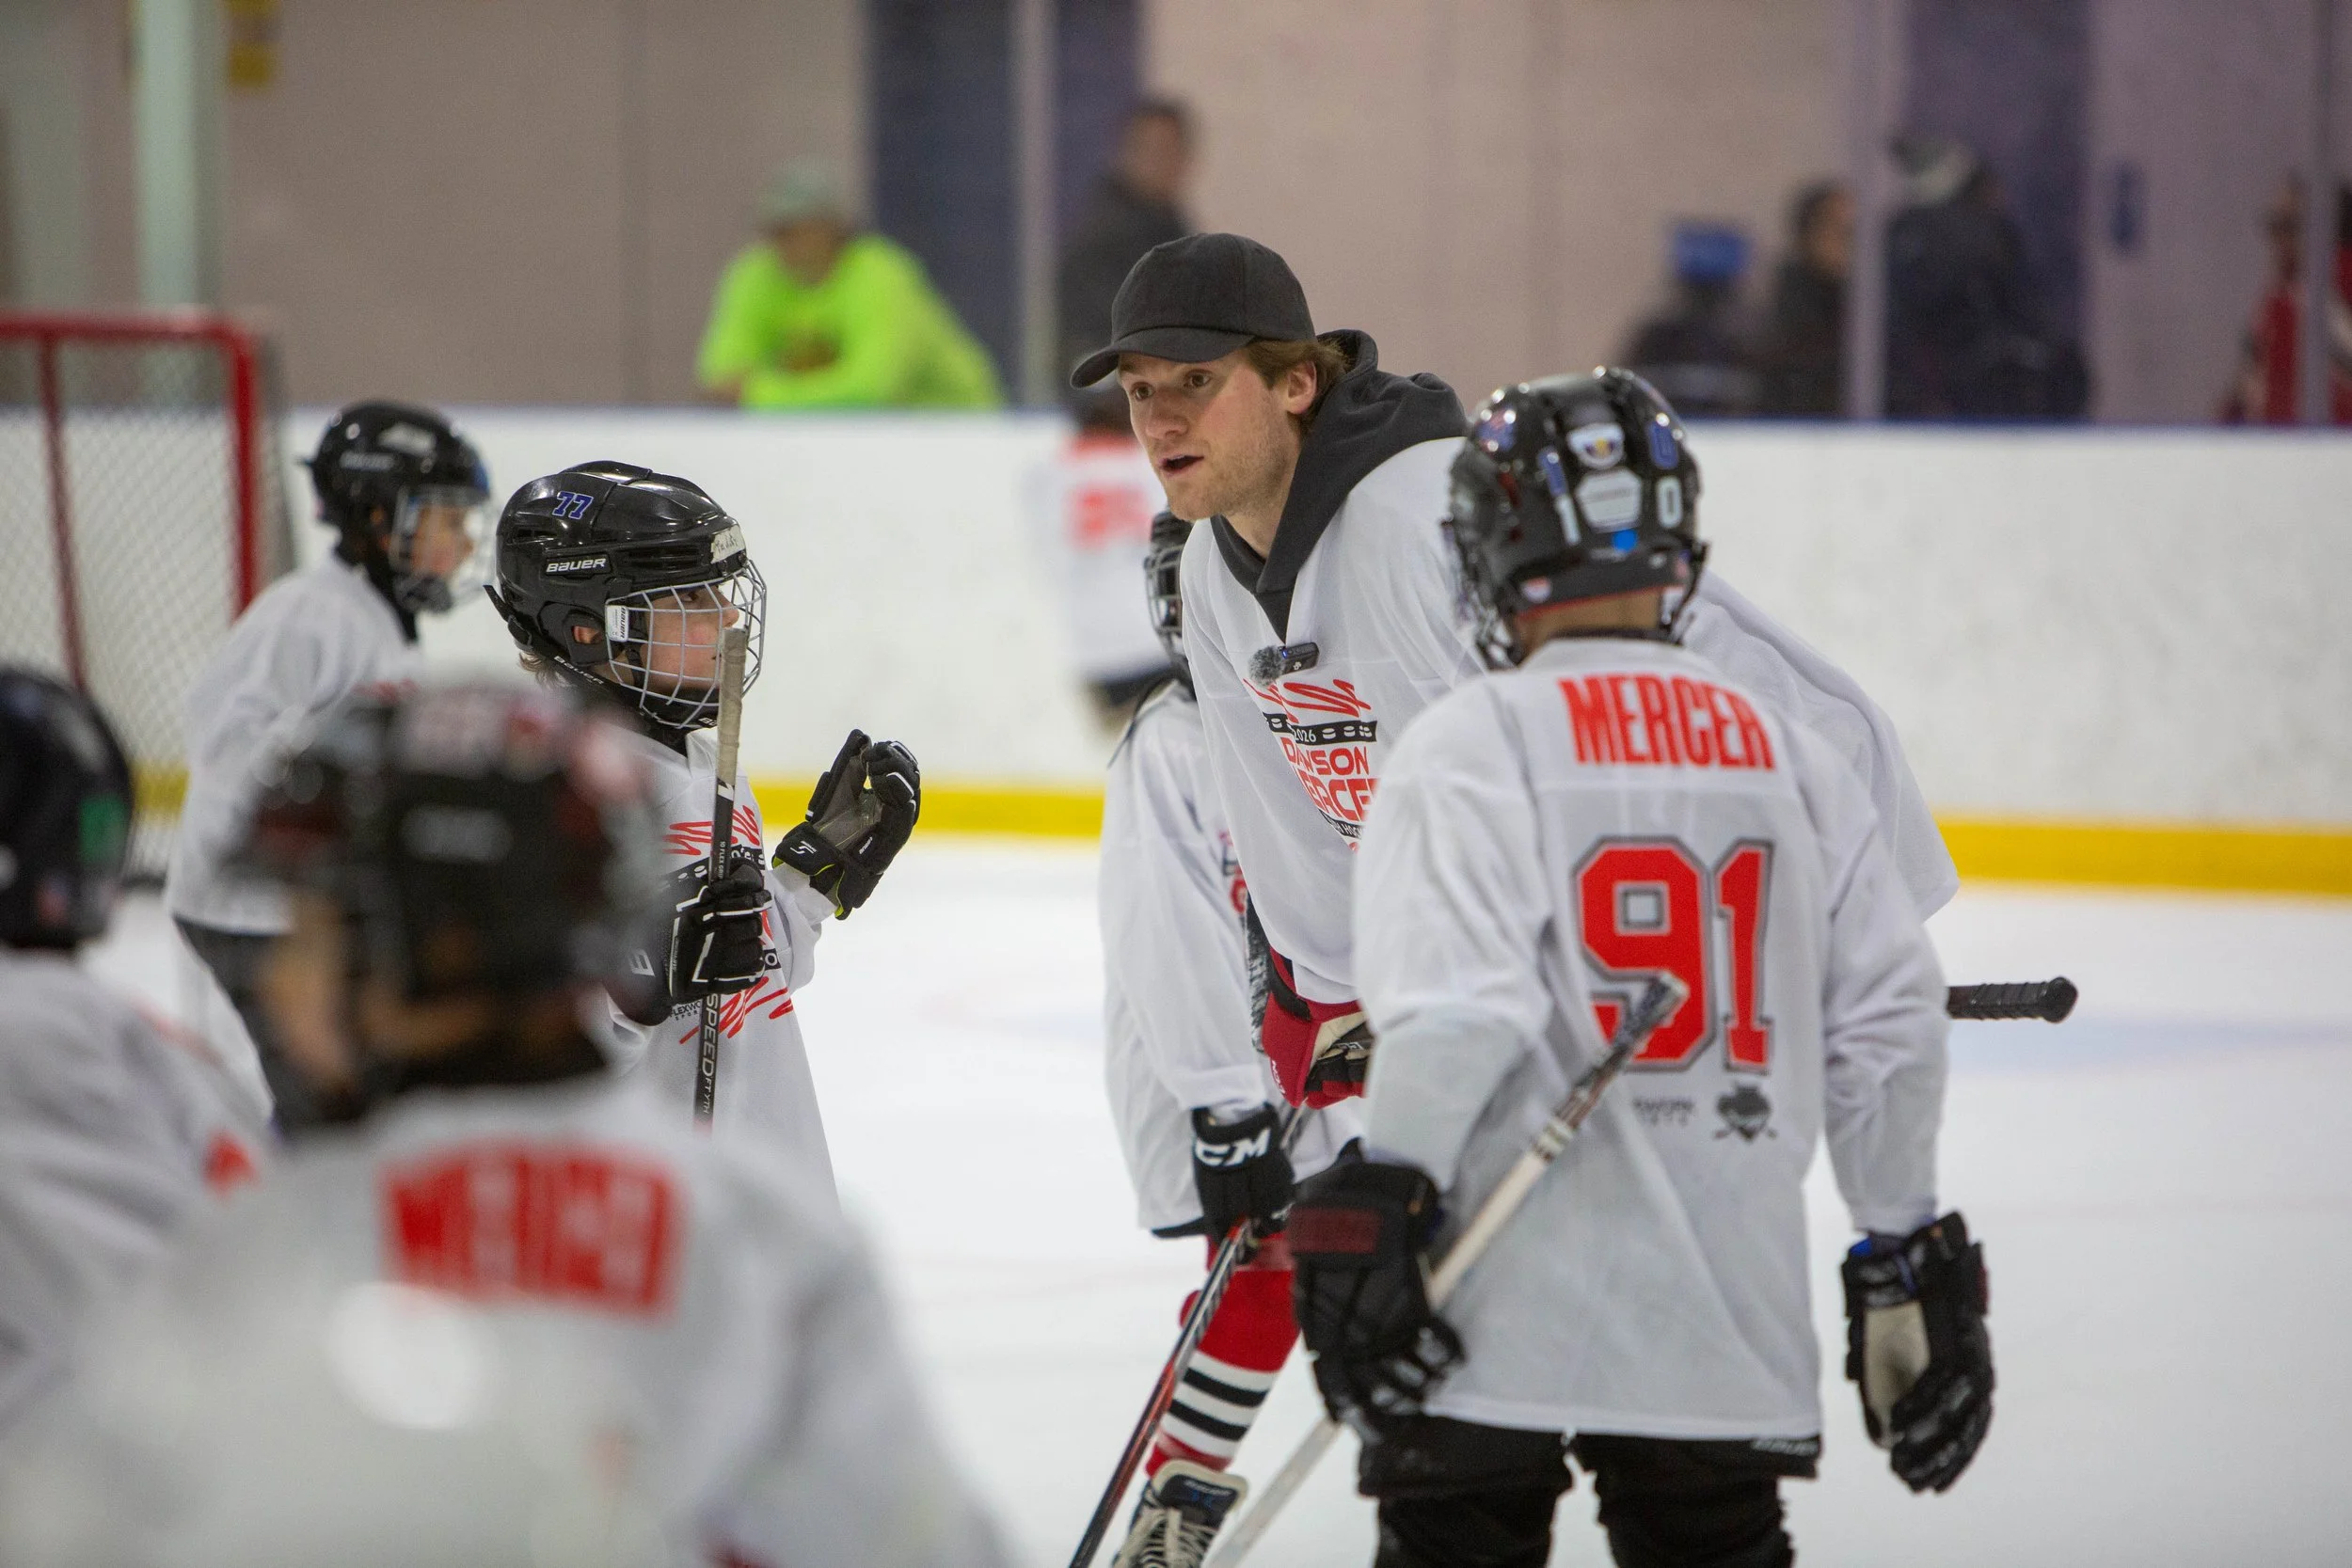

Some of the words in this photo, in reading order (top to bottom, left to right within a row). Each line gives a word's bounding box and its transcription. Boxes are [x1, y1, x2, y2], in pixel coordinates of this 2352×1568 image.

[551, 490, 595, 520] 77
[546, 558, 607, 573] BAUER
[553, 656, 604, 685] BAUER
[1290, 727, 1317, 743] 2026
[1557, 673, 1777, 773] MERCER
[1295, 767, 1379, 822] ERCE
[1570, 835, 1774, 1074] 91
